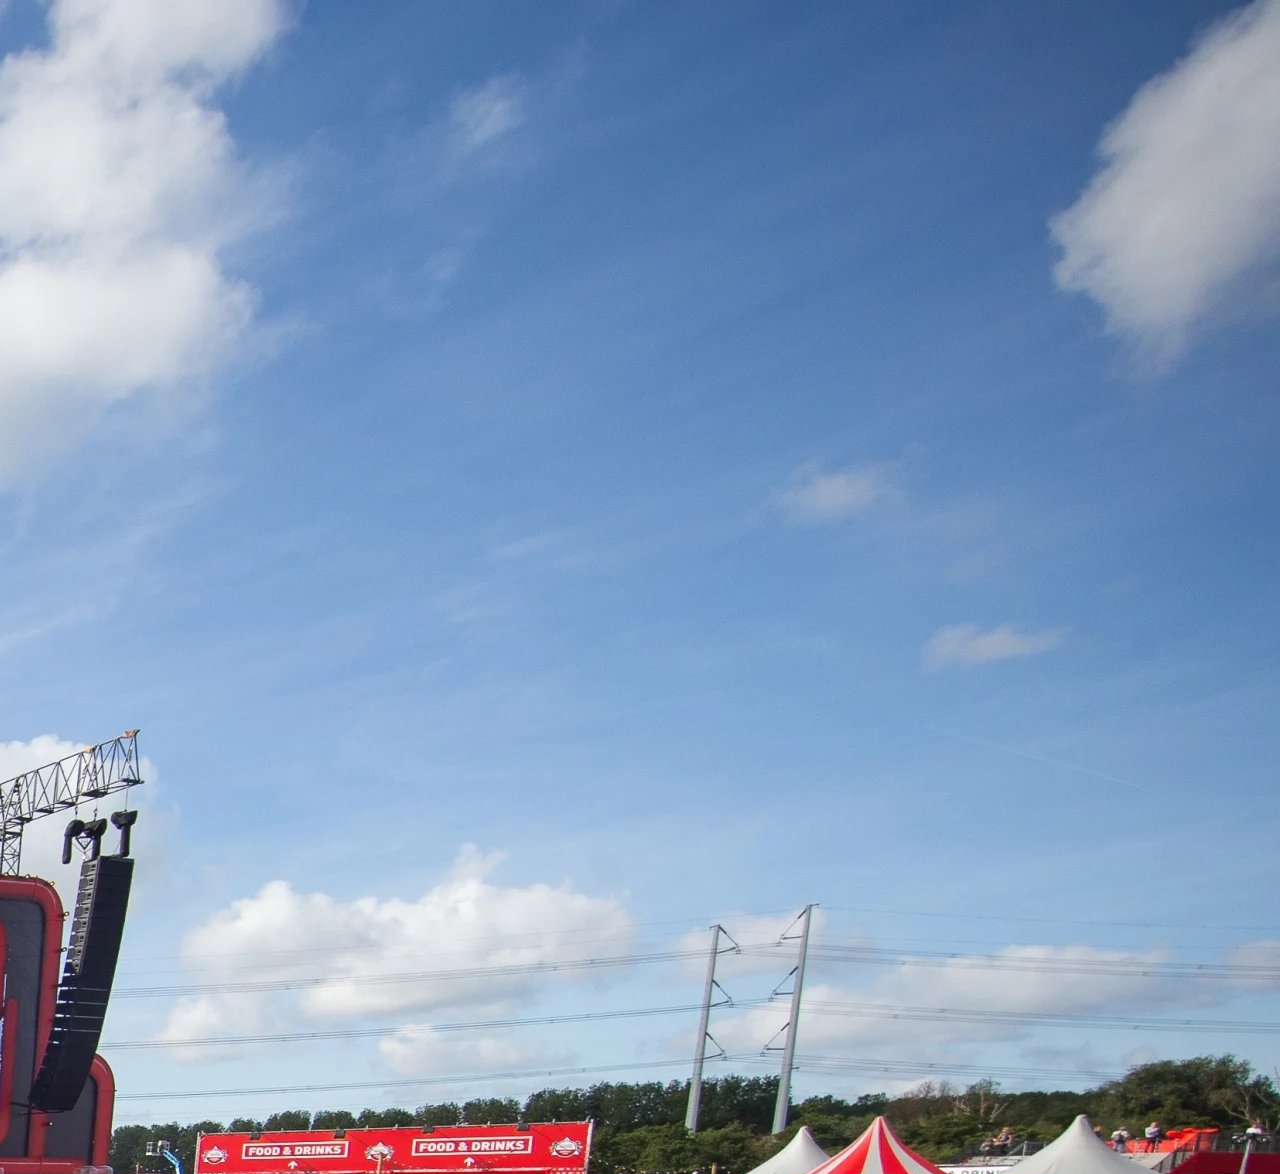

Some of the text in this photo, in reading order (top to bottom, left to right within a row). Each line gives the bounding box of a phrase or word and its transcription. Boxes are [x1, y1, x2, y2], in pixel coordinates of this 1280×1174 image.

[248, 1145, 341, 1156] FOOD & DRINKS
[419, 1140, 524, 1152] FOOD & DRINKS
